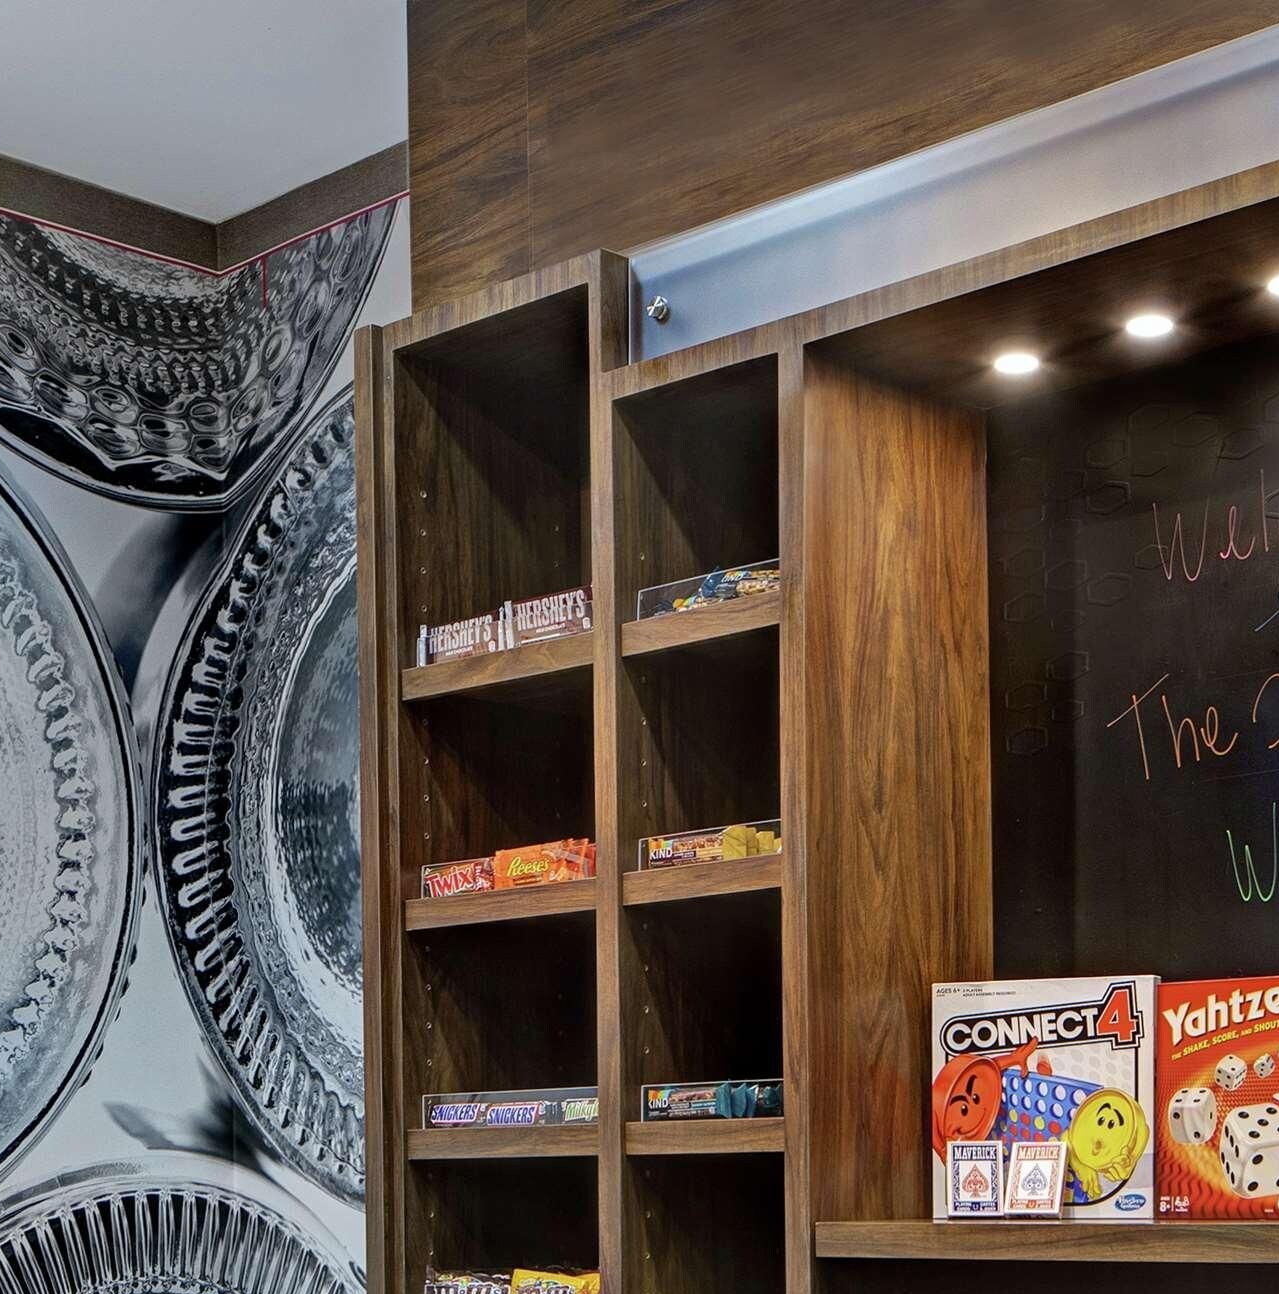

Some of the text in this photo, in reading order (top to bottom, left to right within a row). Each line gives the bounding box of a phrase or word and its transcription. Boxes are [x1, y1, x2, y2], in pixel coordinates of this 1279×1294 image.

[517, 589, 586, 632] HERSHEY'S
[429, 614, 492, 651] HERSHEY'S
[1107, 673, 1238, 781] The
[649, 848, 673, 861] KIND
[506, 856, 551, 877] Reese's
[946, 988, 1137, 1050] CONNECT 4
[1183, 1040, 1210, 1057] SHAKE,
[1212, 1030, 1240, 1045] SCORE,
[431, 1104, 478, 1122] SNICKERS
[486, 1105, 536, 1126] SNICKERS
[954, 1146, 997, 1161] MAVERICK
[1017, 1146, 1060, 1161] MAVERICK
